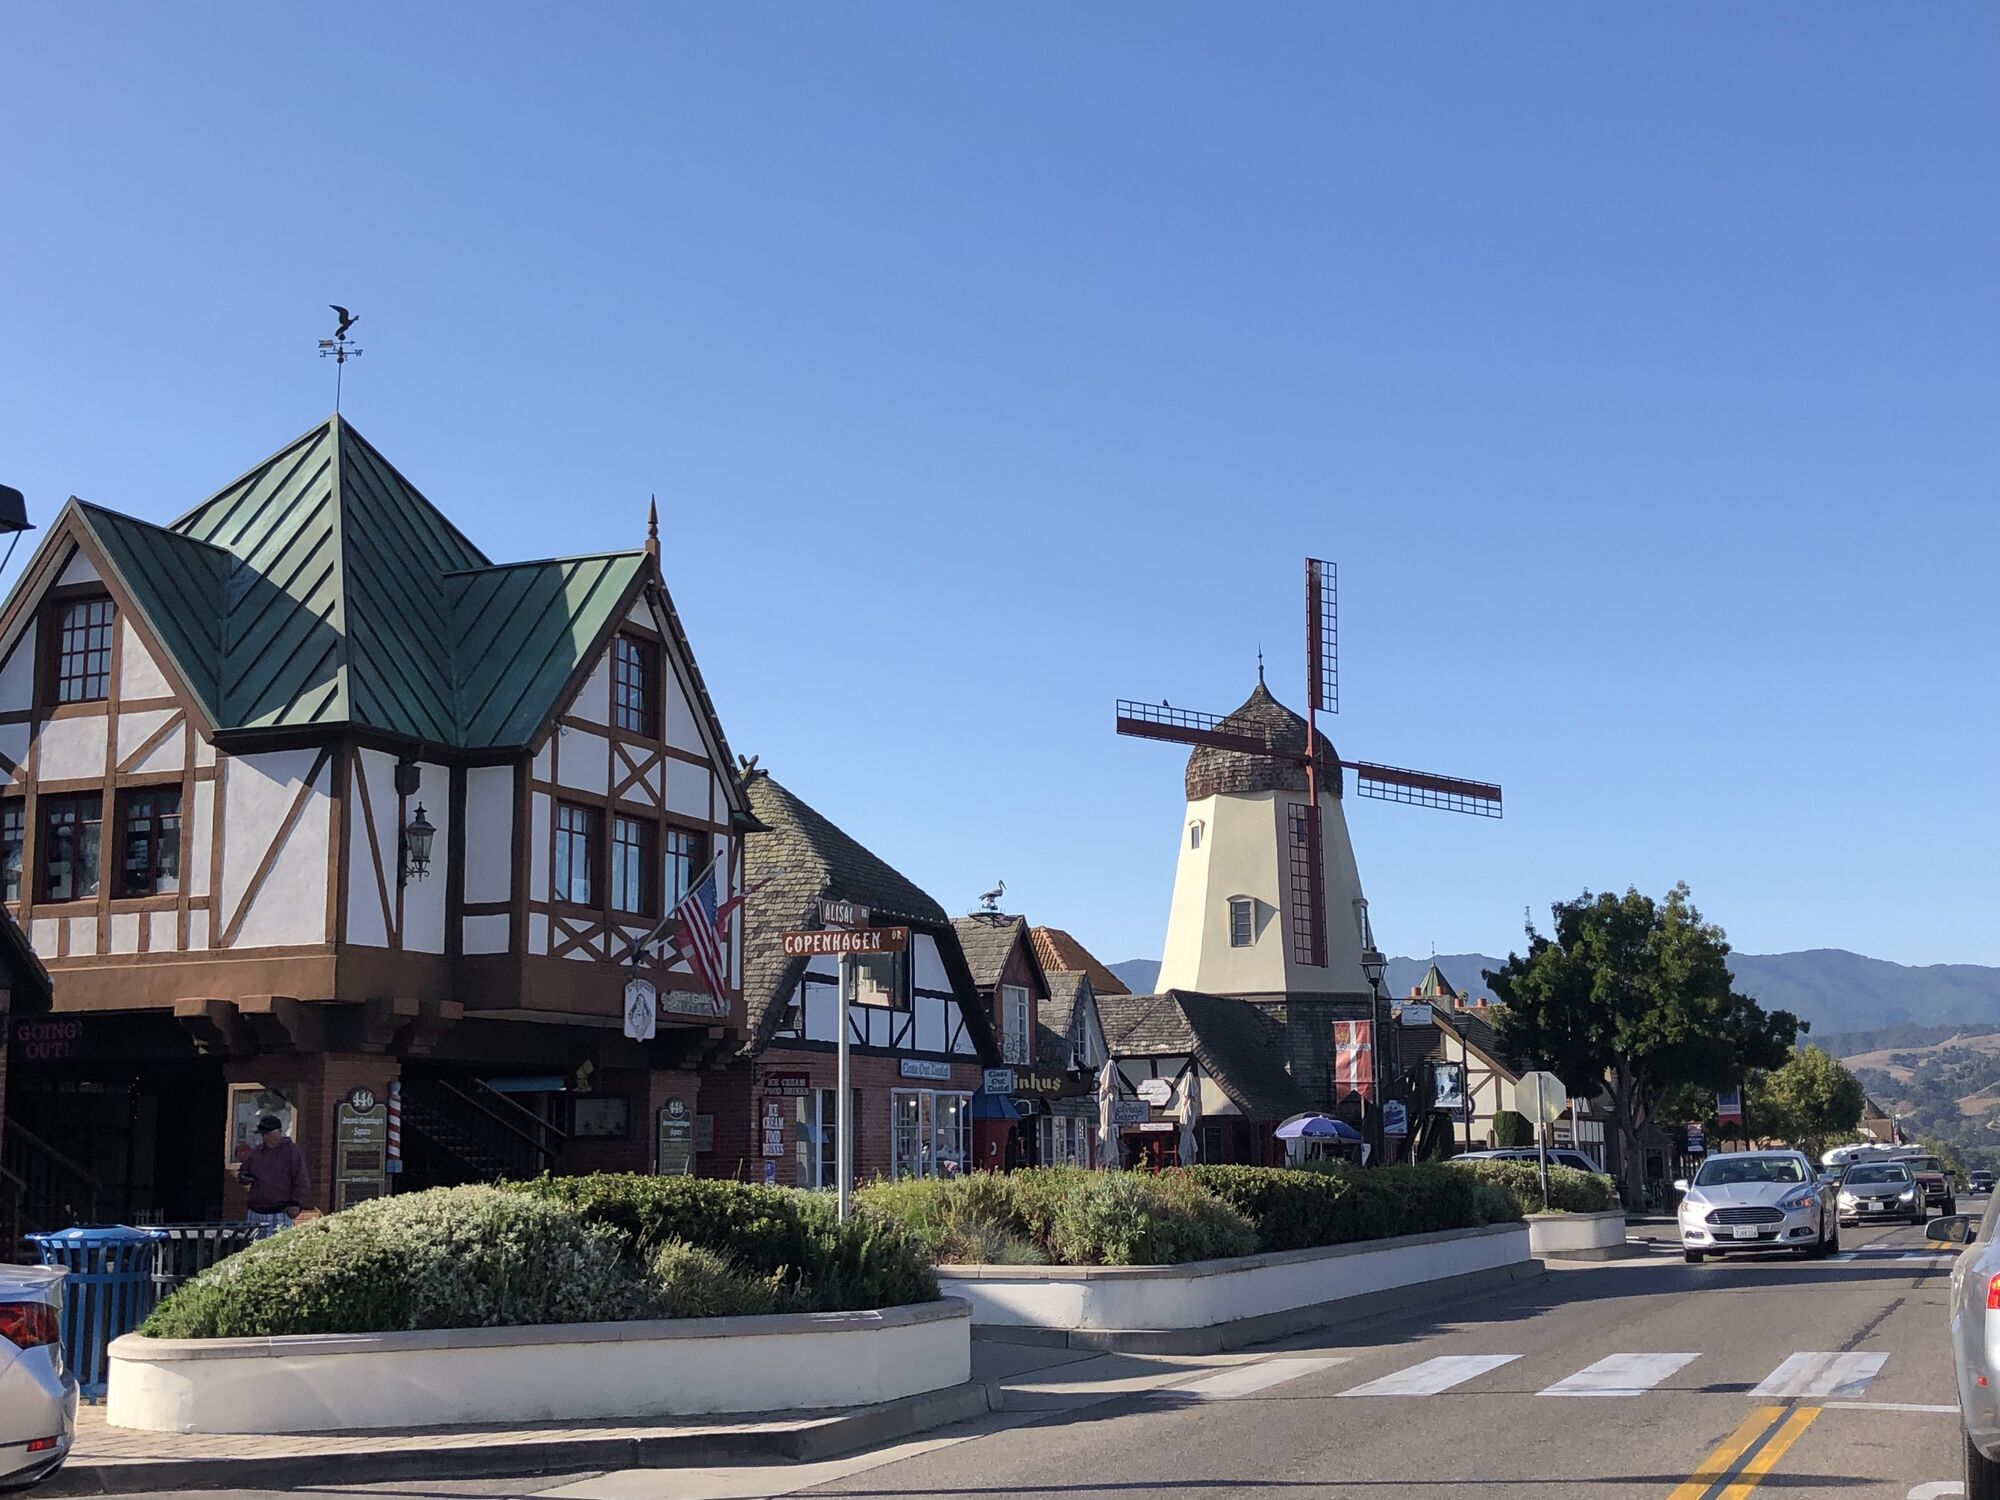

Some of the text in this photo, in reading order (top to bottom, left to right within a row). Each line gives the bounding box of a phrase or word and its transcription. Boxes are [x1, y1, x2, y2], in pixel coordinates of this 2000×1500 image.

[825, 903, 854, 924] ALISAL
[785, 931, 881, 953] COPENHAGEN
[17, 1023, 77, 1041] GOING
[781, 1079, 806, 1087] CREAM
[1014, 1073, 1062, 1093] inhus
[765, 1087, 809, 1095] FOOD DRINKS
[353, 1092, 374, 1107] 446
[669, 1101, 684, 1114] 446
[768, 1103, 779, 1116] ICE
[763, 1117, 784, 1129] CREAM
[765, 1130, 781, 1143] FOOD
[763, 1143, 784, 1156] DRINKS
